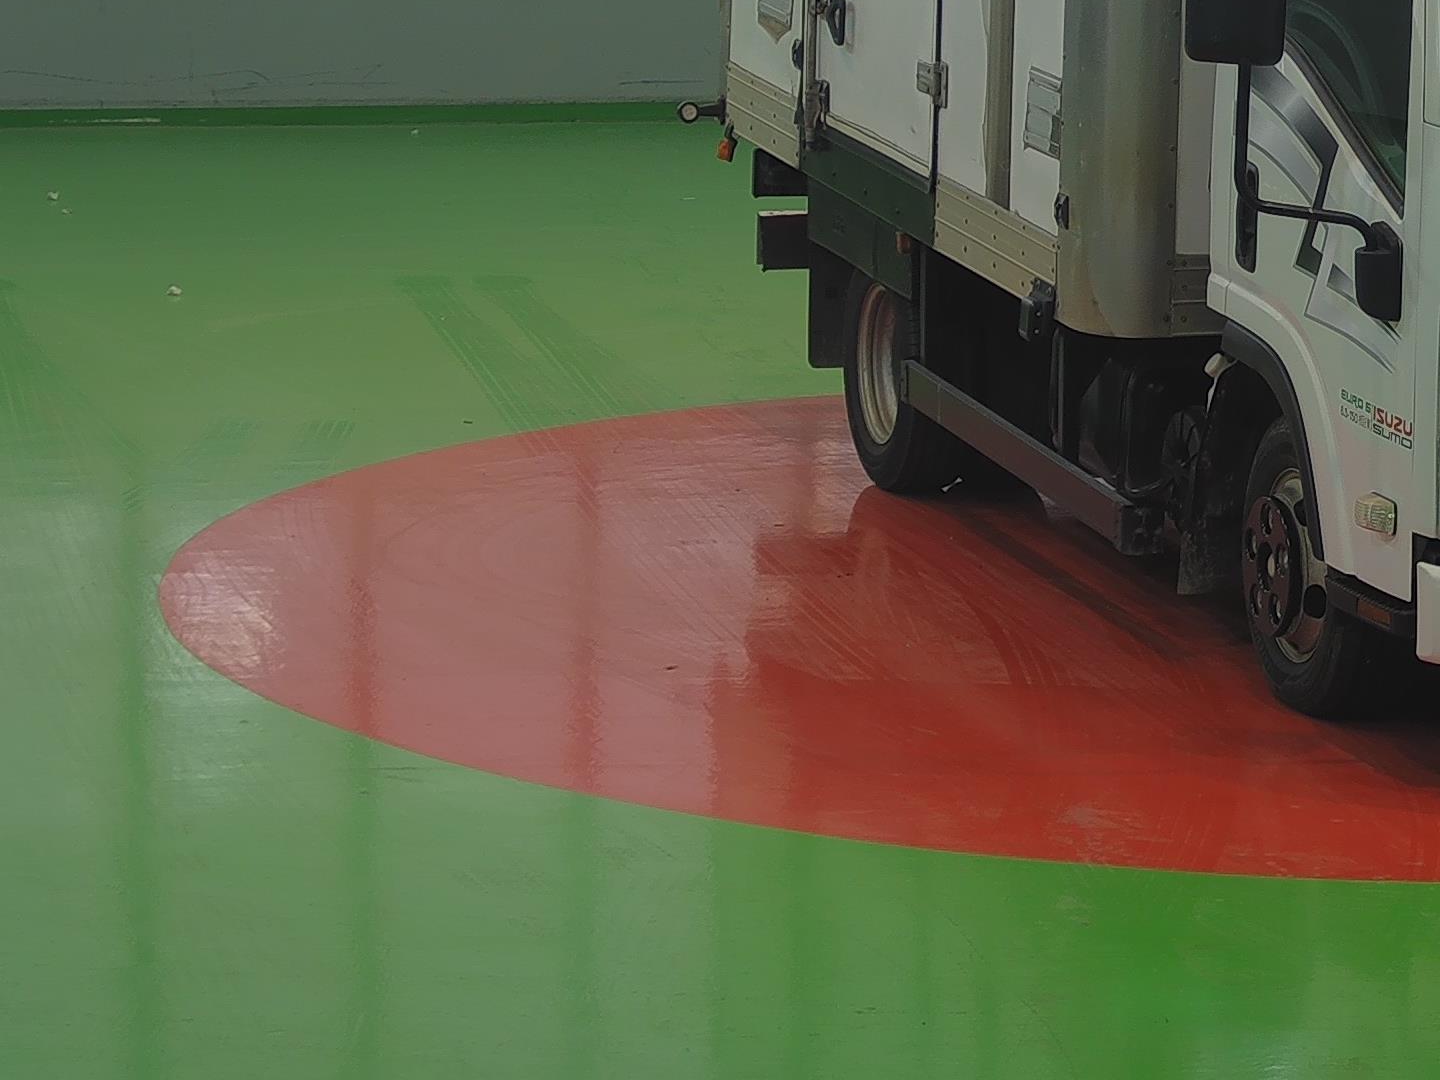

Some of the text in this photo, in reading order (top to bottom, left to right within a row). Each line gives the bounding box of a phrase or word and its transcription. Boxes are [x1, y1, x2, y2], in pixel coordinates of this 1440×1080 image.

[1340, 388, 1364, 410] EURO
[1373, 405, 1413, 437] ISUZU
[1372, 423, 1413, 450] SUMO
